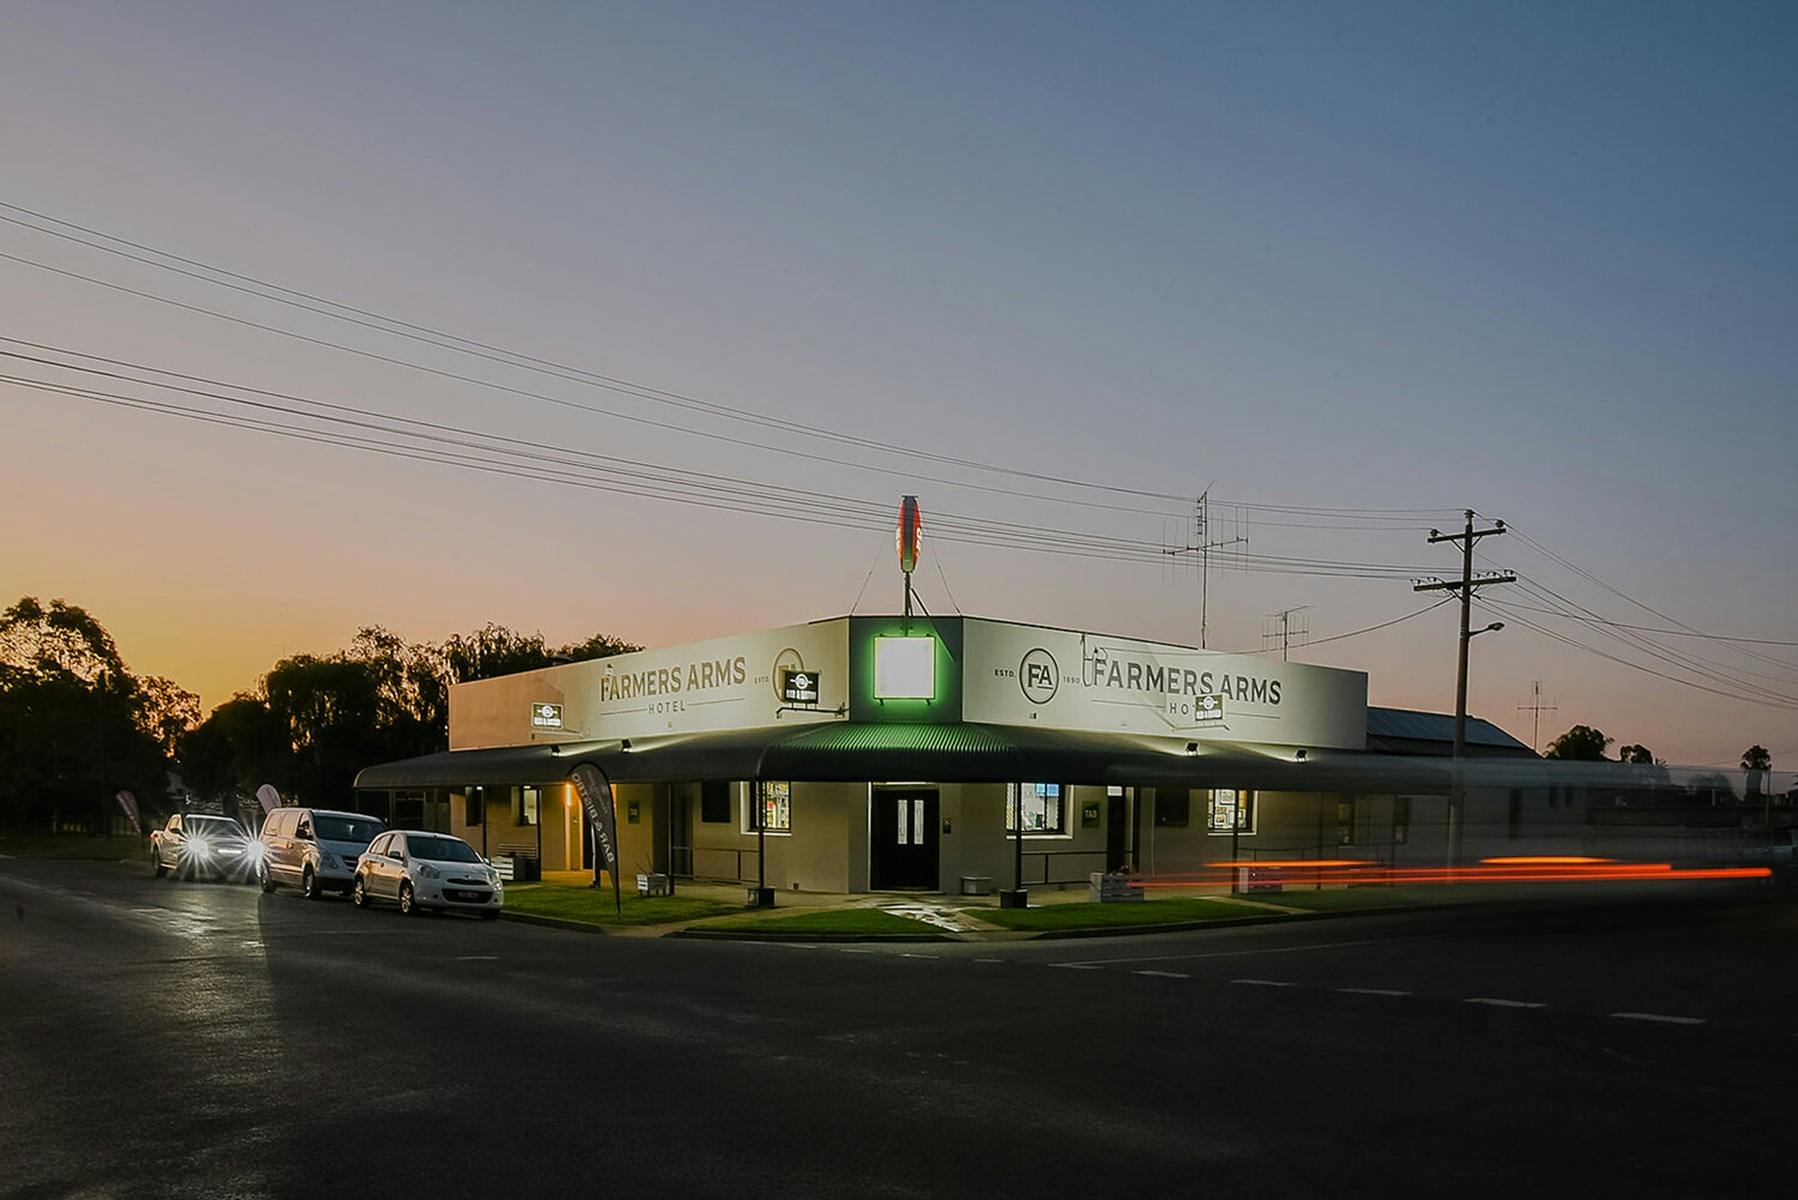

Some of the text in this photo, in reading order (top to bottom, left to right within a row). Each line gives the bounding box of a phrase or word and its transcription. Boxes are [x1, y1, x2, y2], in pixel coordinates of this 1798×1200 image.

[600, 655, 747, 702] FARMERS ARMS
[1027, 663, 1053, 689] FA
[1092, 659, 1282, 706] FARMERS ARMS
[648, 699, 686, 715] HOTEL
